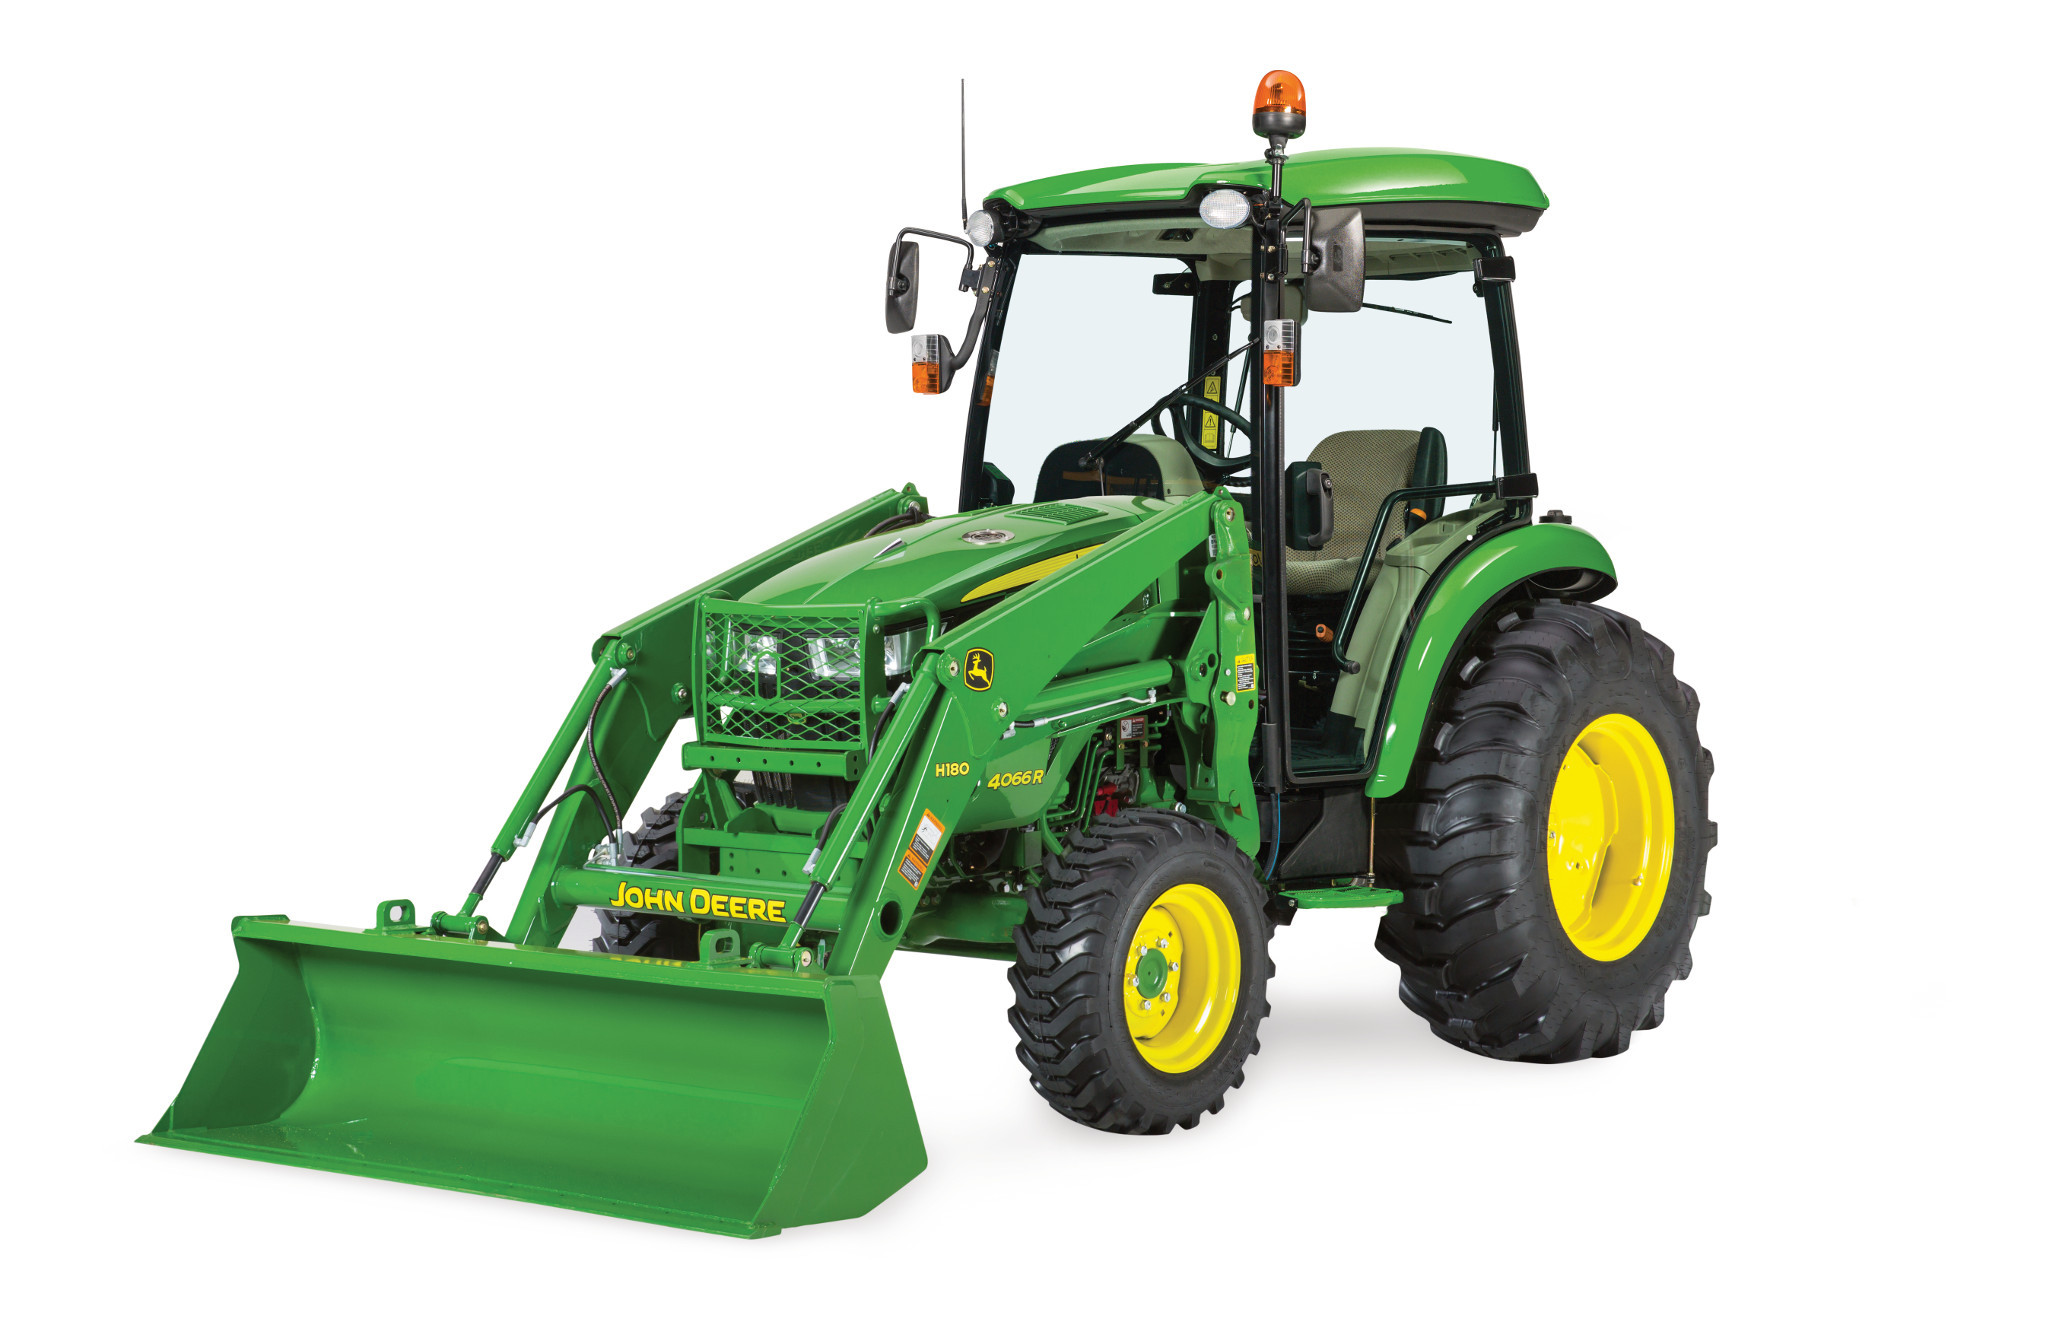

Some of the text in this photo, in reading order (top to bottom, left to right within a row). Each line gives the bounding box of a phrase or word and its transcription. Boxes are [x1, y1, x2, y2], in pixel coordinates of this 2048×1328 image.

[935, 761, 970, 778] H180
[987, 769, 1044, 790] 4066R
[609, 881, 787, 923] JOHN DEERE
